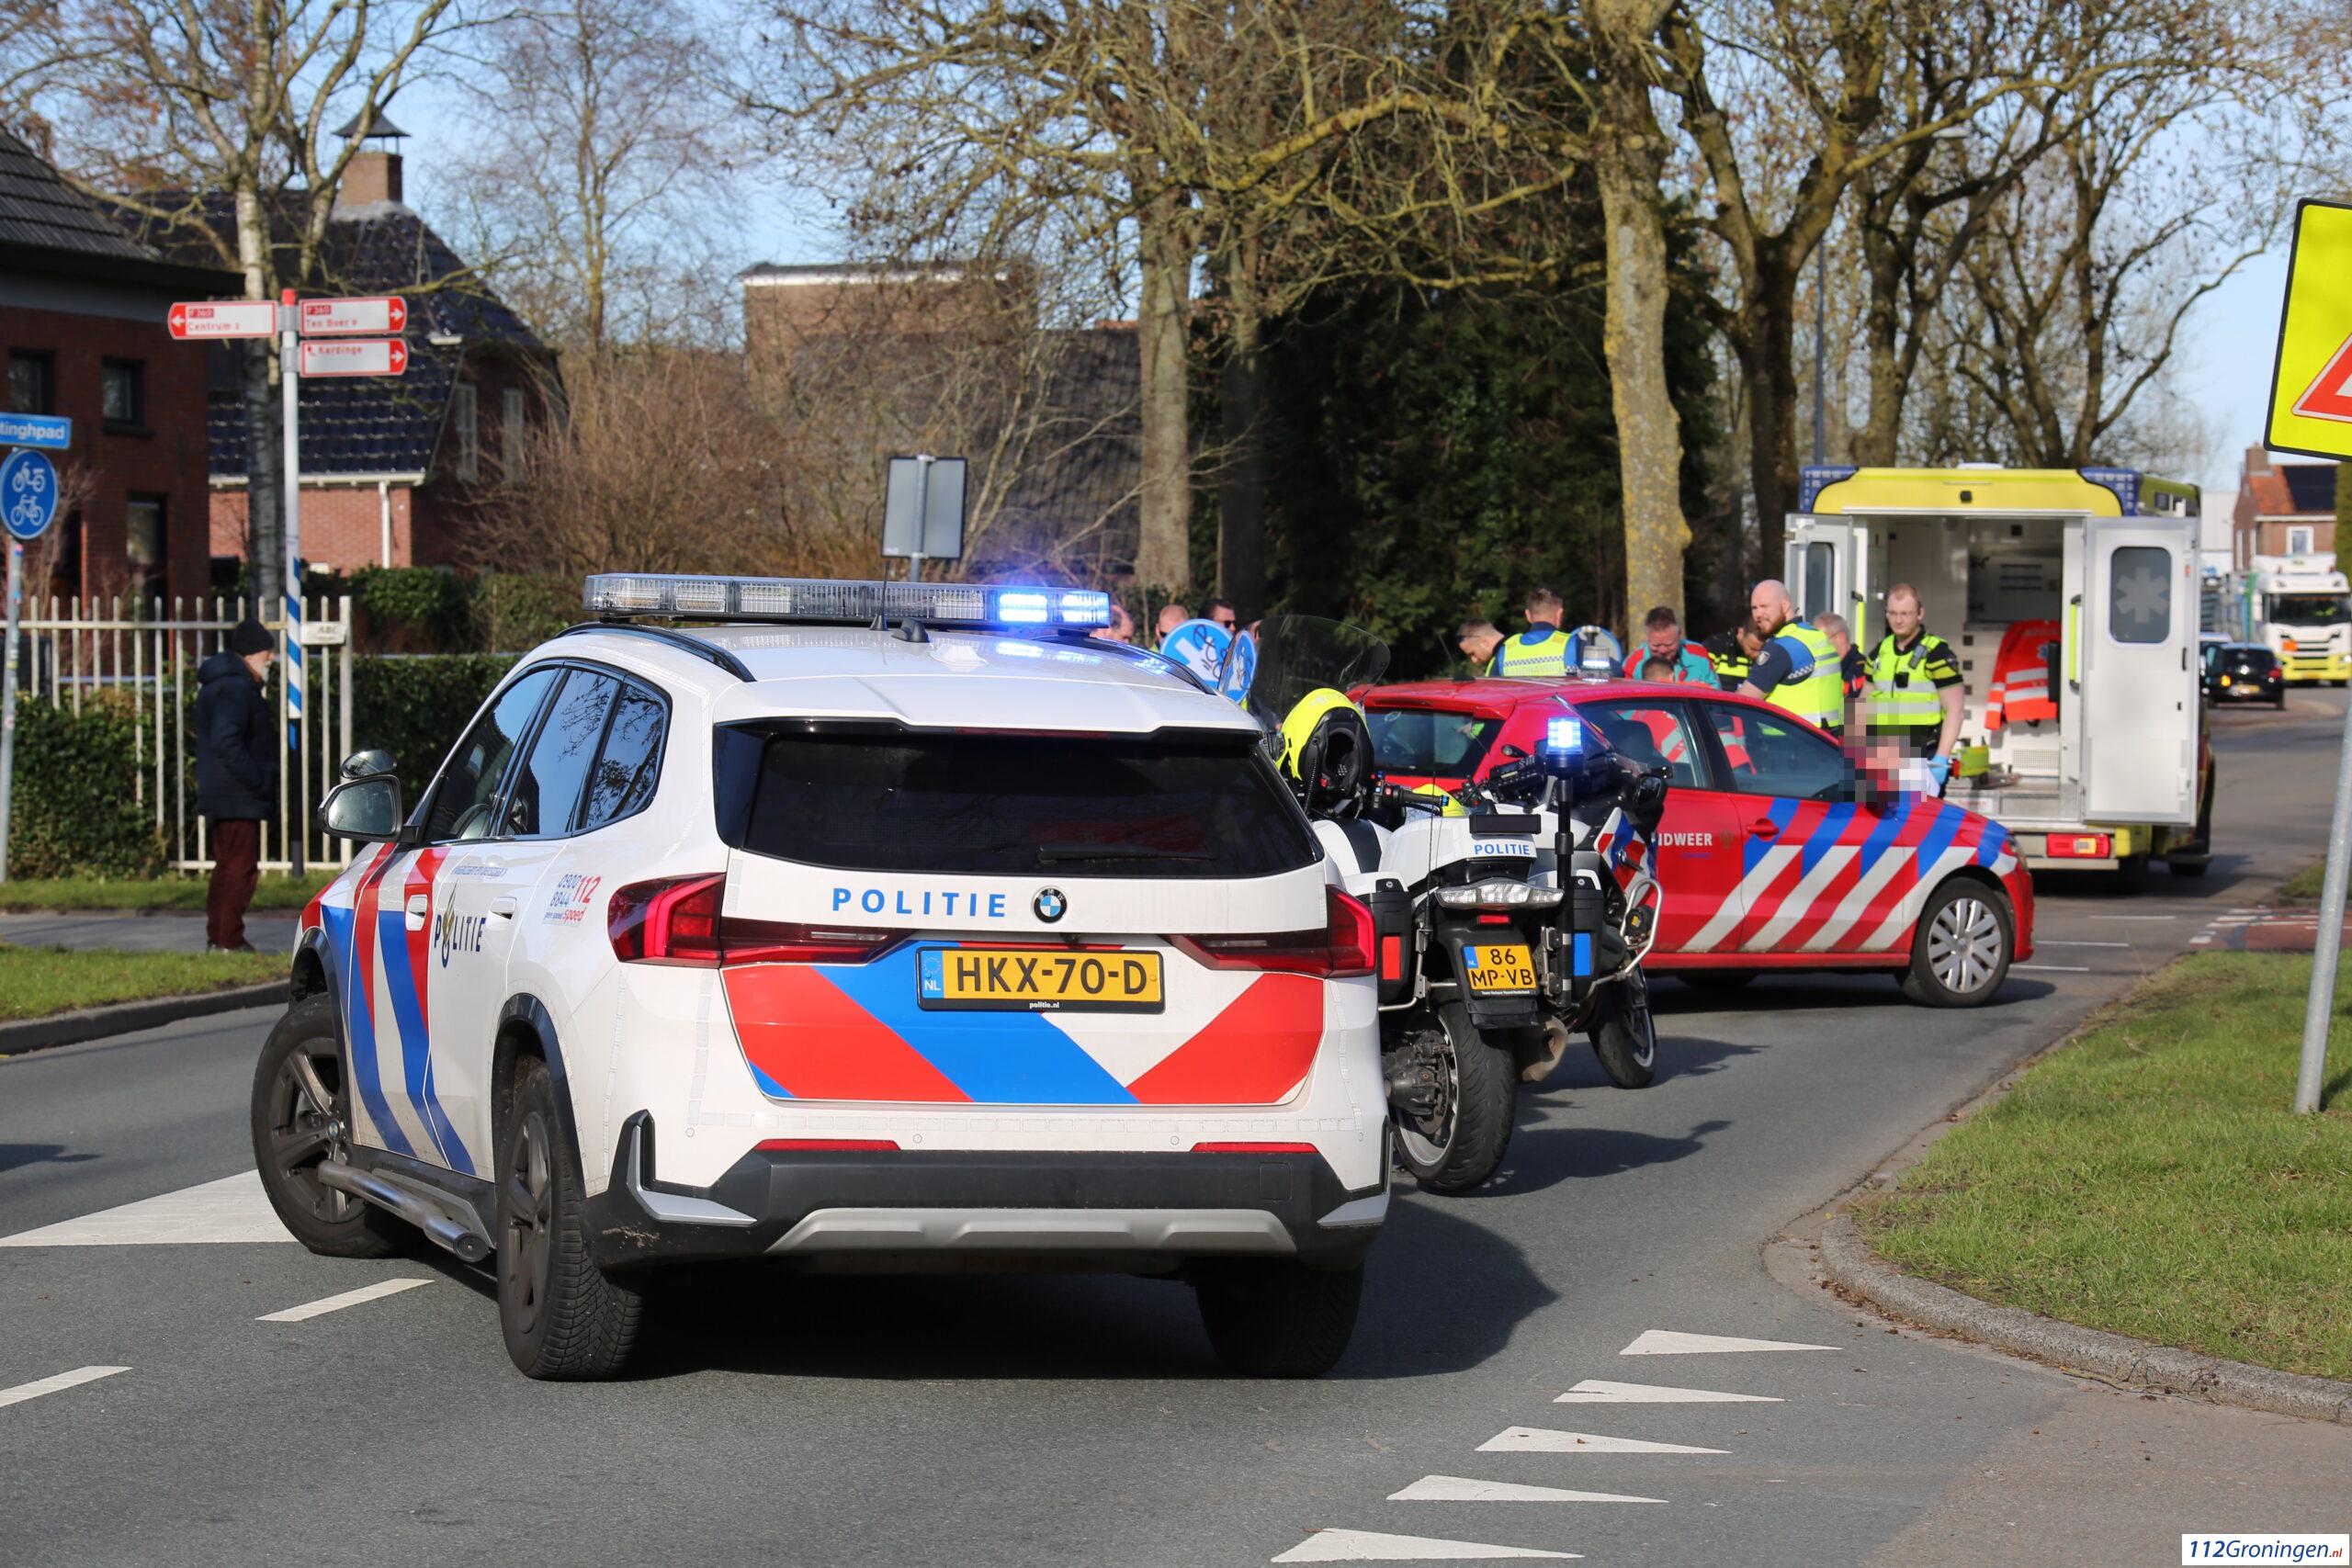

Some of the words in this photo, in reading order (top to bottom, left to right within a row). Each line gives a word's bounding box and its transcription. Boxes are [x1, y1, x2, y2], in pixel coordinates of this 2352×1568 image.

[188, 322, 231, 331] Centrum
[1475, 843, 1531, 855] POLITIE
[558, 874, 582, 888] 0900
[572, 875, 602, 903] 112
[550, 891, 571, 907] 8844
[832, 887, 1006, 918] POLITIE
[562, 907, 586, 923] spoed
[435, 914, 486, 968] POLITIE
[1490, 948, 1516, 964] 86
[956, 956, 1148, 995] HKX-70-D
[1471, 968, 1532, 987] MP-VB
[924, 979, 941, 991] NL
[1029, 1001, 1060, 1010] politie.nl
